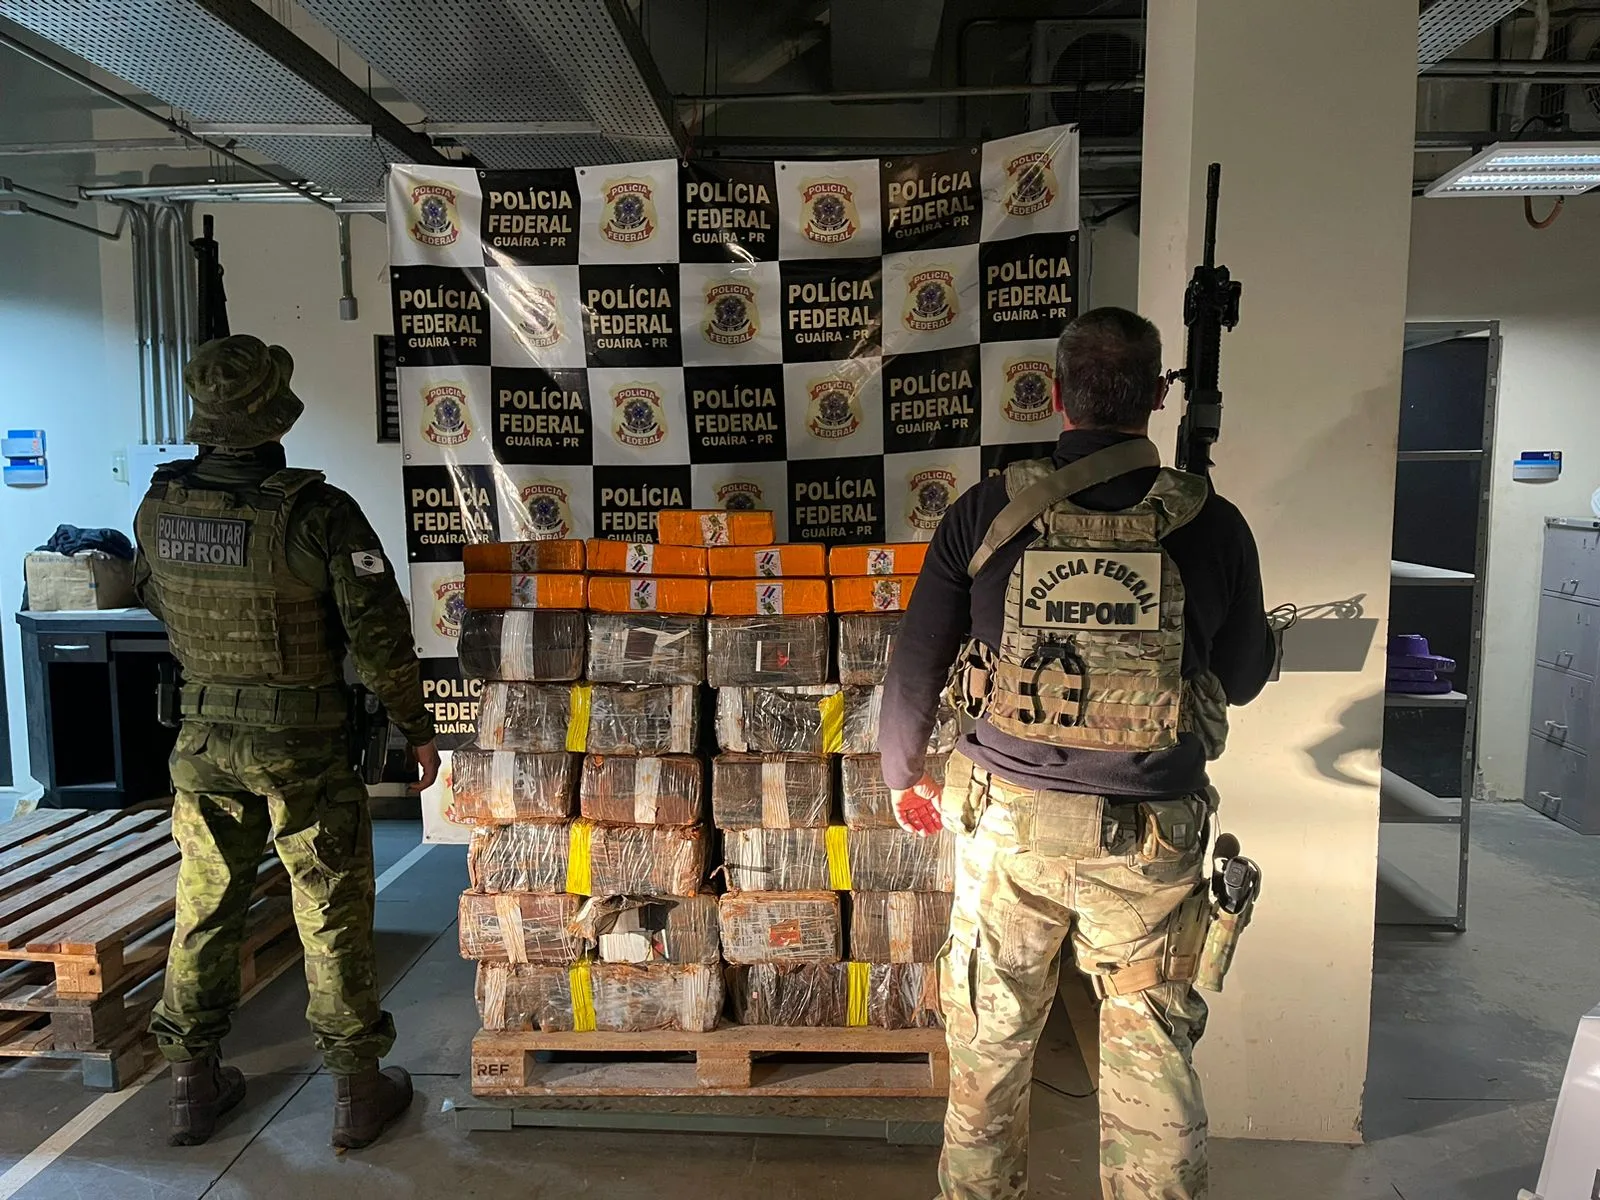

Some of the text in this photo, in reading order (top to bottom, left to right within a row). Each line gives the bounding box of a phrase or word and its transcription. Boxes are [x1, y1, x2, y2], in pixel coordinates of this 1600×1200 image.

[687, 178, 770, 204] POLÍCIA
[888, 171, 972, 202] POLÍCIA
[489, 187, 572, 209] POLÍCIA
[687, 209, 770, 229] FEDERAL
[888, 196, 974, 228] FEDERAL
[489, 215, 571, 233] FEDERAL
[895, 222, 942, 238] GUAÍRA
[954, 215, 969, 226] PR
[494, 236, 539, 246] GUAÍRA
[551, 237, 565, 246] PR
[608, 232, 648, 241] FEDERAL
[693, 233, 738, 243] GUAÍRA
[749, 232, 765, 242] PR
[809, 232, 850, 242] FEDERAL
[988, 254, 1071, 284] POLÍCIA
[400, 285, 481, 310] POLÍCIA
[588, 284, 671, 309] POLÍCIA
[789, 275, 874, 304] POLÍCIA
[988, 284, 1071, 309] FEDERAL
[402, 314, 482, 333] FEDERAL
[590, 314, 672, 334] FEDERAL
[789, 307, 874, 329] FEDERAL
[910, 320, 950, 330] FEDERAL
[993, 308, 1038, 322] GUAÍRA
[1050, 308, 1066, 318] PR
[409, 335, 450, 347] GUAÍRA
[461, 337, 476, 347] PR
[597, 336, 642, 348] GUAÍRA
[652, 338, 667, 347] PR
[710, 332, 751, 343] FEDERAL
[796, 330, 842, 343] GUAÍRA
[853, 330, 868, 339] PR
[891, 370, 972, 397] POLÍCIA
[500, 386, 584, 409] POLÍCIA
[693, 385, 776, 409] POLÍCIA
[891, 395, 974, 421] FEDERAL
[1009, 410, 1050, 421] FEDERAL
[500, 414, 584, 433] FEDERAL
[695, 412, 777, 433] FEDERAL
[896, 420, 941, 435] GUAÍRA
[953, 418, 968, 428] PR
[431, 434, 466, 444] FEDERAL
[505, 435, 552, 446] GUAÍRA
[563, 438, 578, 447] PR
[622, 436, 659, 445] FEDERAL
[702, 434, 746, 446] GUAÍRA
[758, 434, 773, 444] PR
[602, 484, 683, 506] POLÍCIA
[796, 476, 876, 501] POLÍCIA
[602, 512, 658, 531] FEDER
[796, 503, 877, 525] FEDERAL
[159, 518, 241, 545] POLÍCIA MILITAR
[420, 532, 462, 544] GUAÍRA
[802, 526, 846, 538] GUAÍRA
[857, 526, 872, 535] PR
[159, 539, 240, 565] BPFRON
[1094, 559, 1158, 614] FEDERAL
[1046, 601, 1136, 625] NEPOM
[477, 1064, 509, 1077] REF
